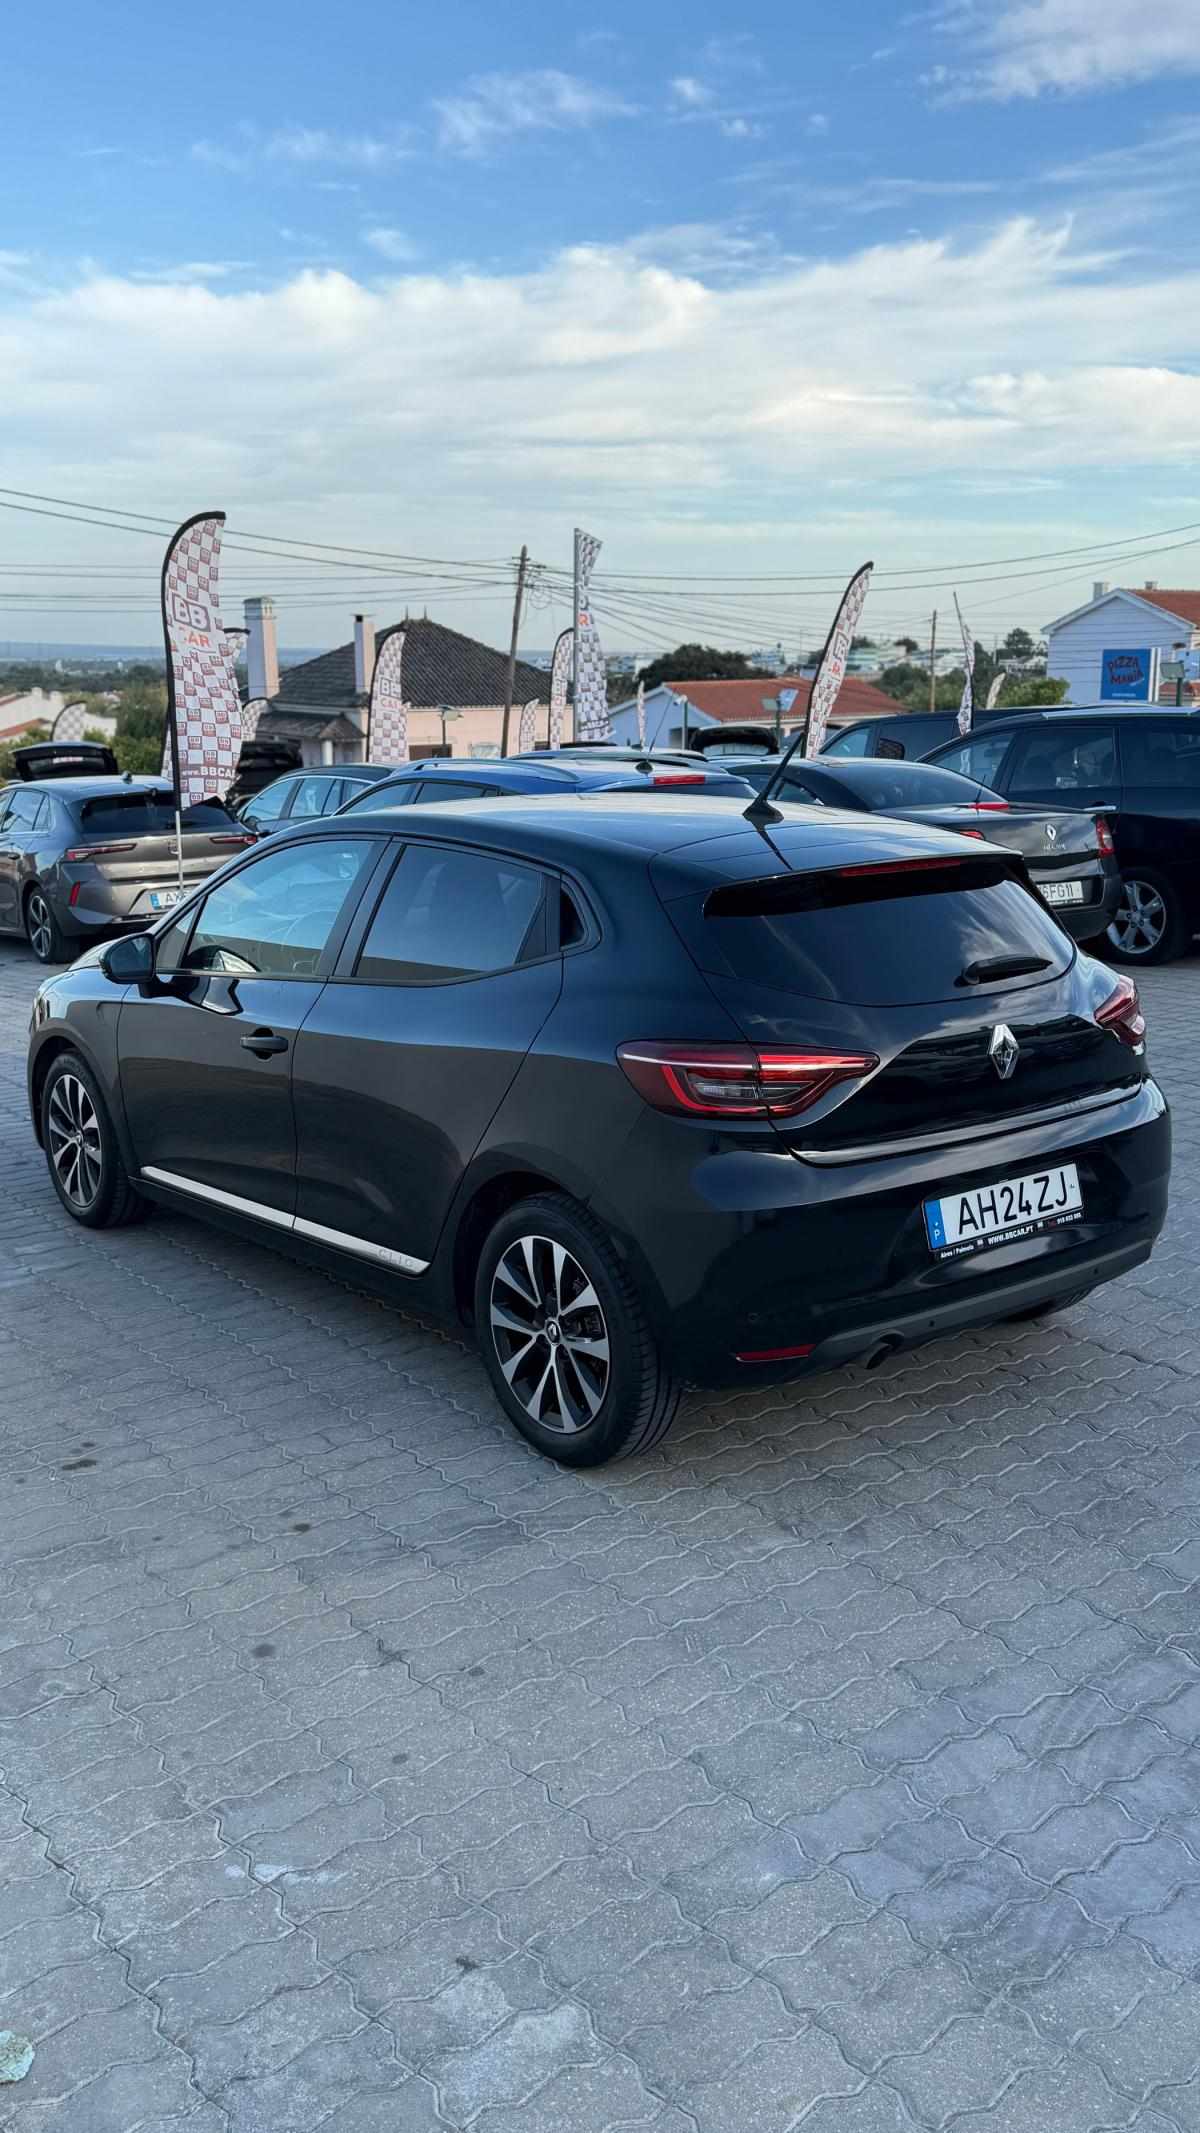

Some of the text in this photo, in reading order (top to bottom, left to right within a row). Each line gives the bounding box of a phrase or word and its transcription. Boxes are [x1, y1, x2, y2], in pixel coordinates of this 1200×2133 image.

[173, 594, 211, 632] BB
[958, 1171, 1068, 1235] AH24ZJ
[934, 1229, 941, 1241] P
